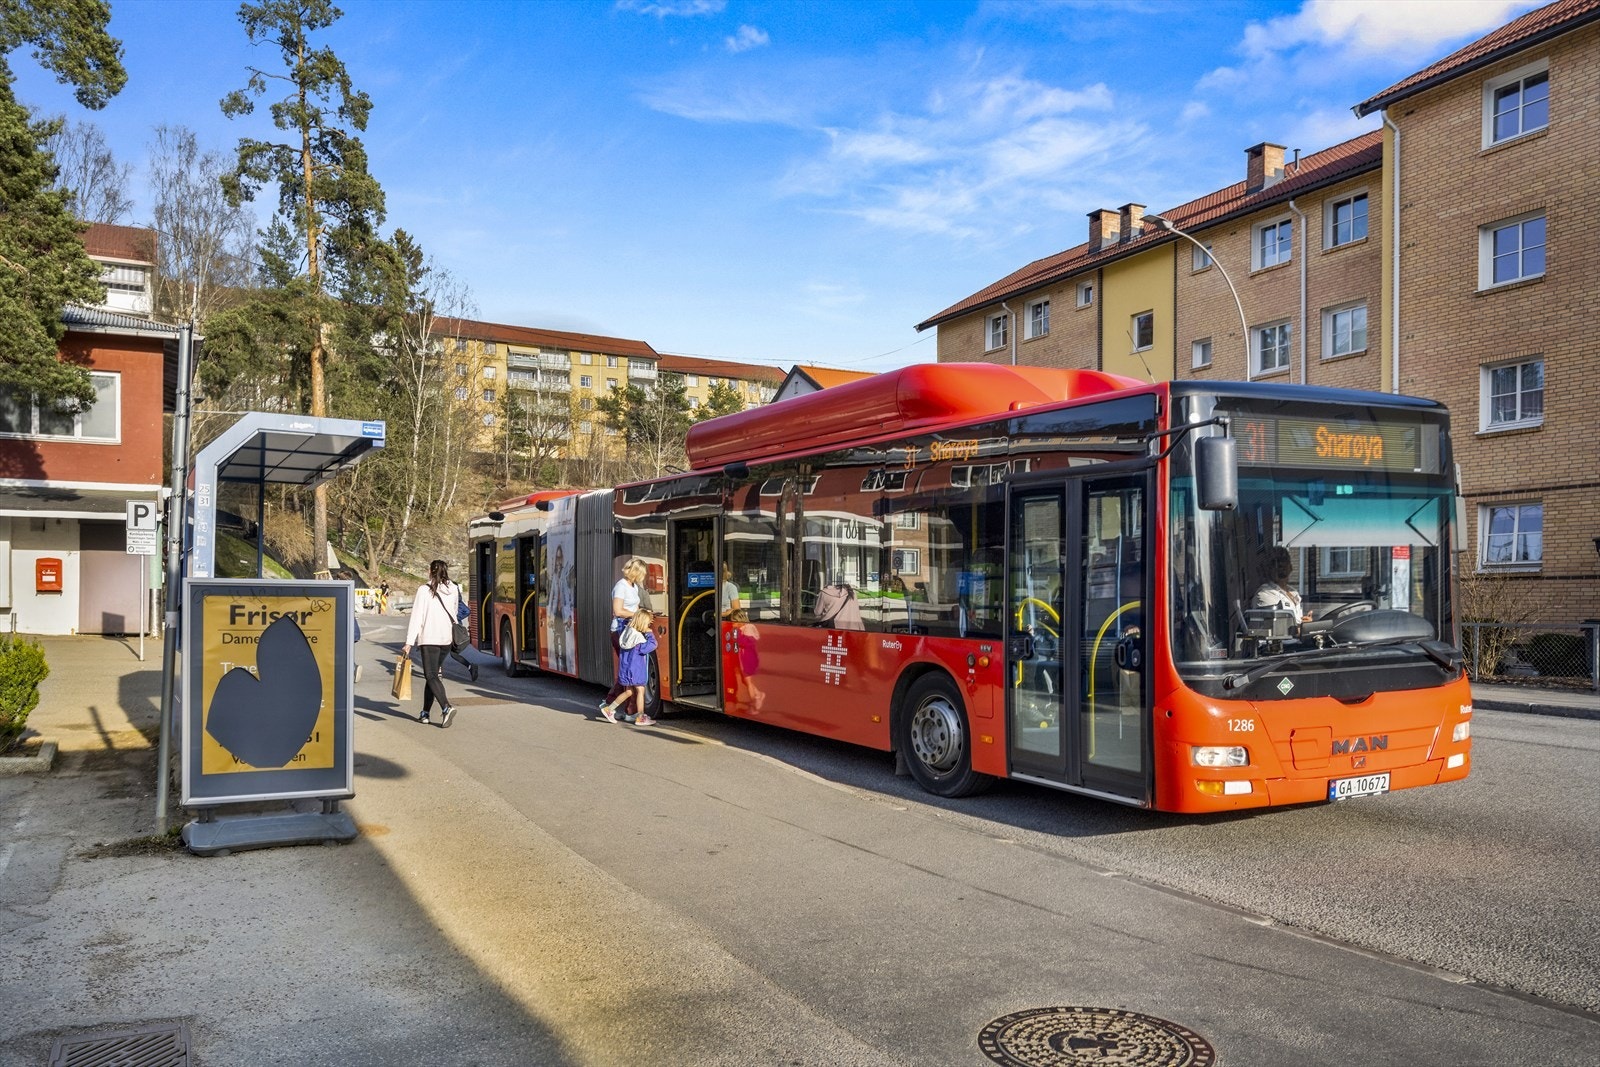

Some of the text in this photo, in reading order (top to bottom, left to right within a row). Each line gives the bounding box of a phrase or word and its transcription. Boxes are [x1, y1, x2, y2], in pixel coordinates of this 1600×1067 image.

[1244, 421, 1383, 466] 31 Snarøya
[903, 445, 916, 470] 31
[199, 496, 209, 505] 31
[133, 504, 150, 527] P
[1227, 719, 1255, 732] 1286
[1332, 735, 1388, 756] MAN
[1339, 776, 1386, 795] GA 10672
